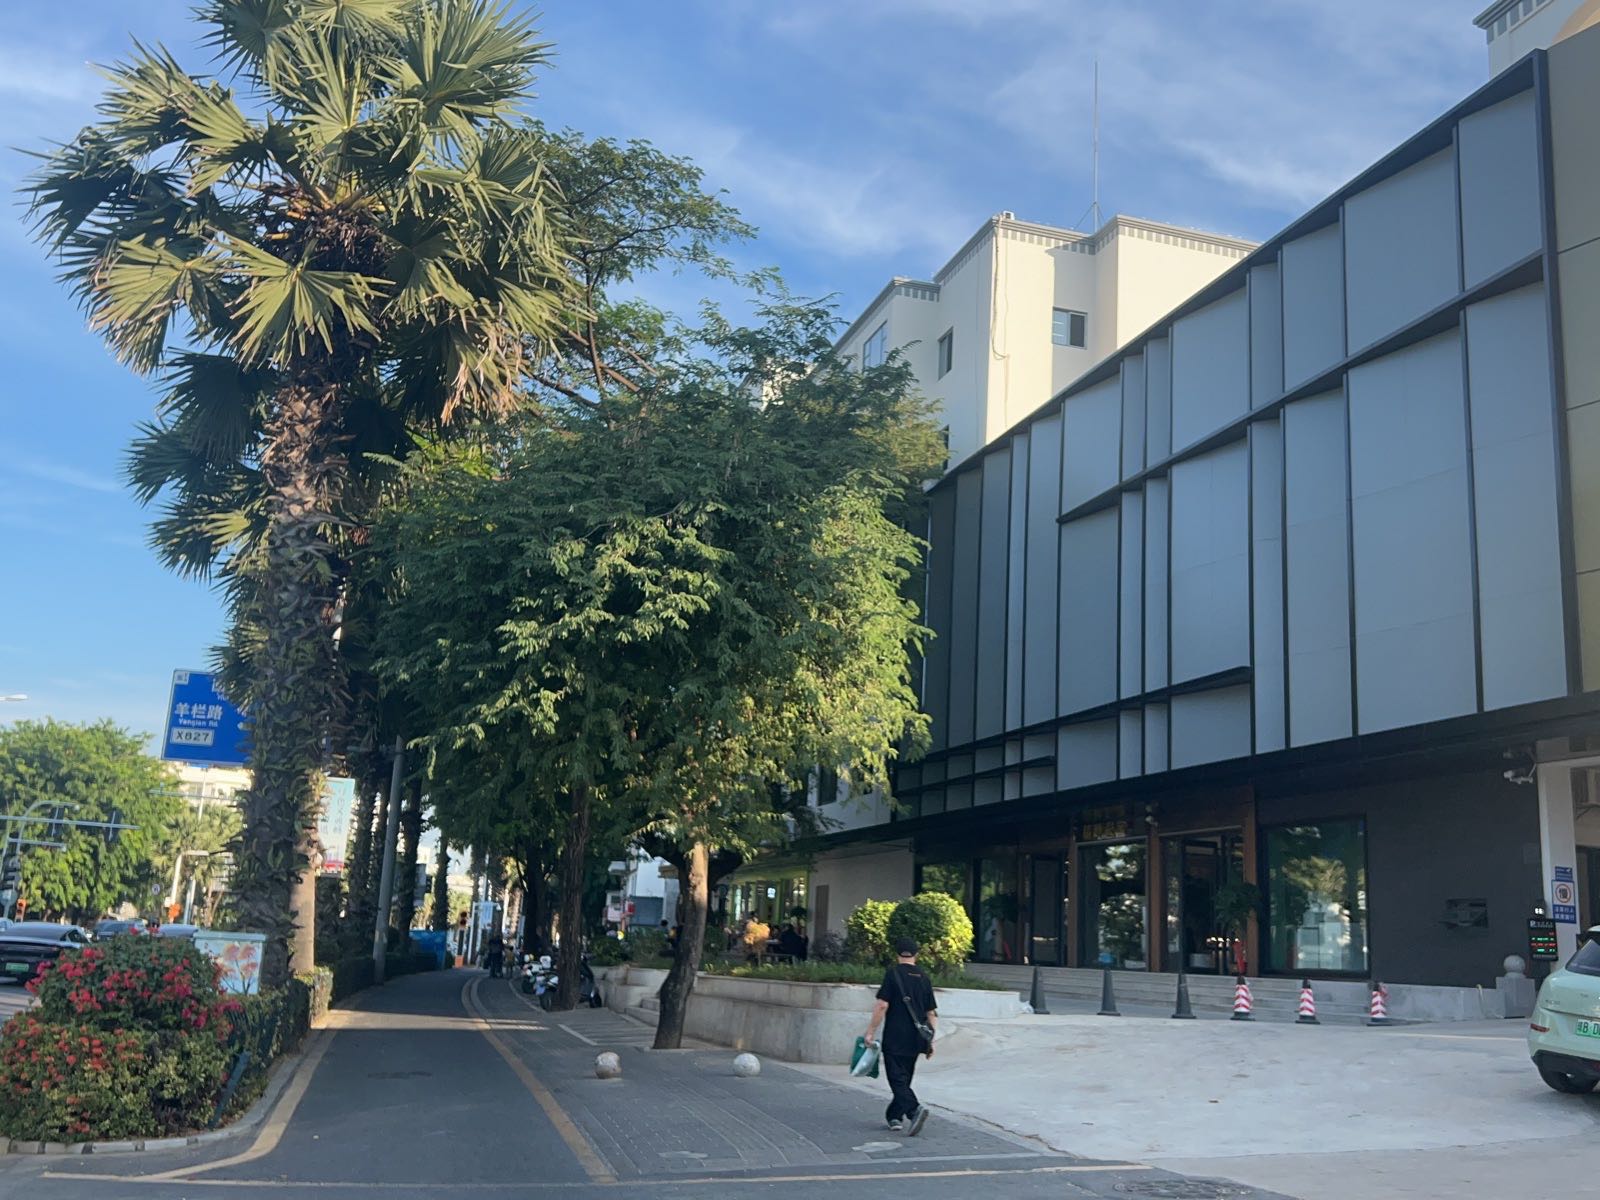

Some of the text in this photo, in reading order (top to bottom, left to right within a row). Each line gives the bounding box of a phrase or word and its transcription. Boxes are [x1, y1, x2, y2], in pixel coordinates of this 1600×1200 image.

[174, 702, 222, 720] 羊栏路
[176, 730, 209, 741] X827
